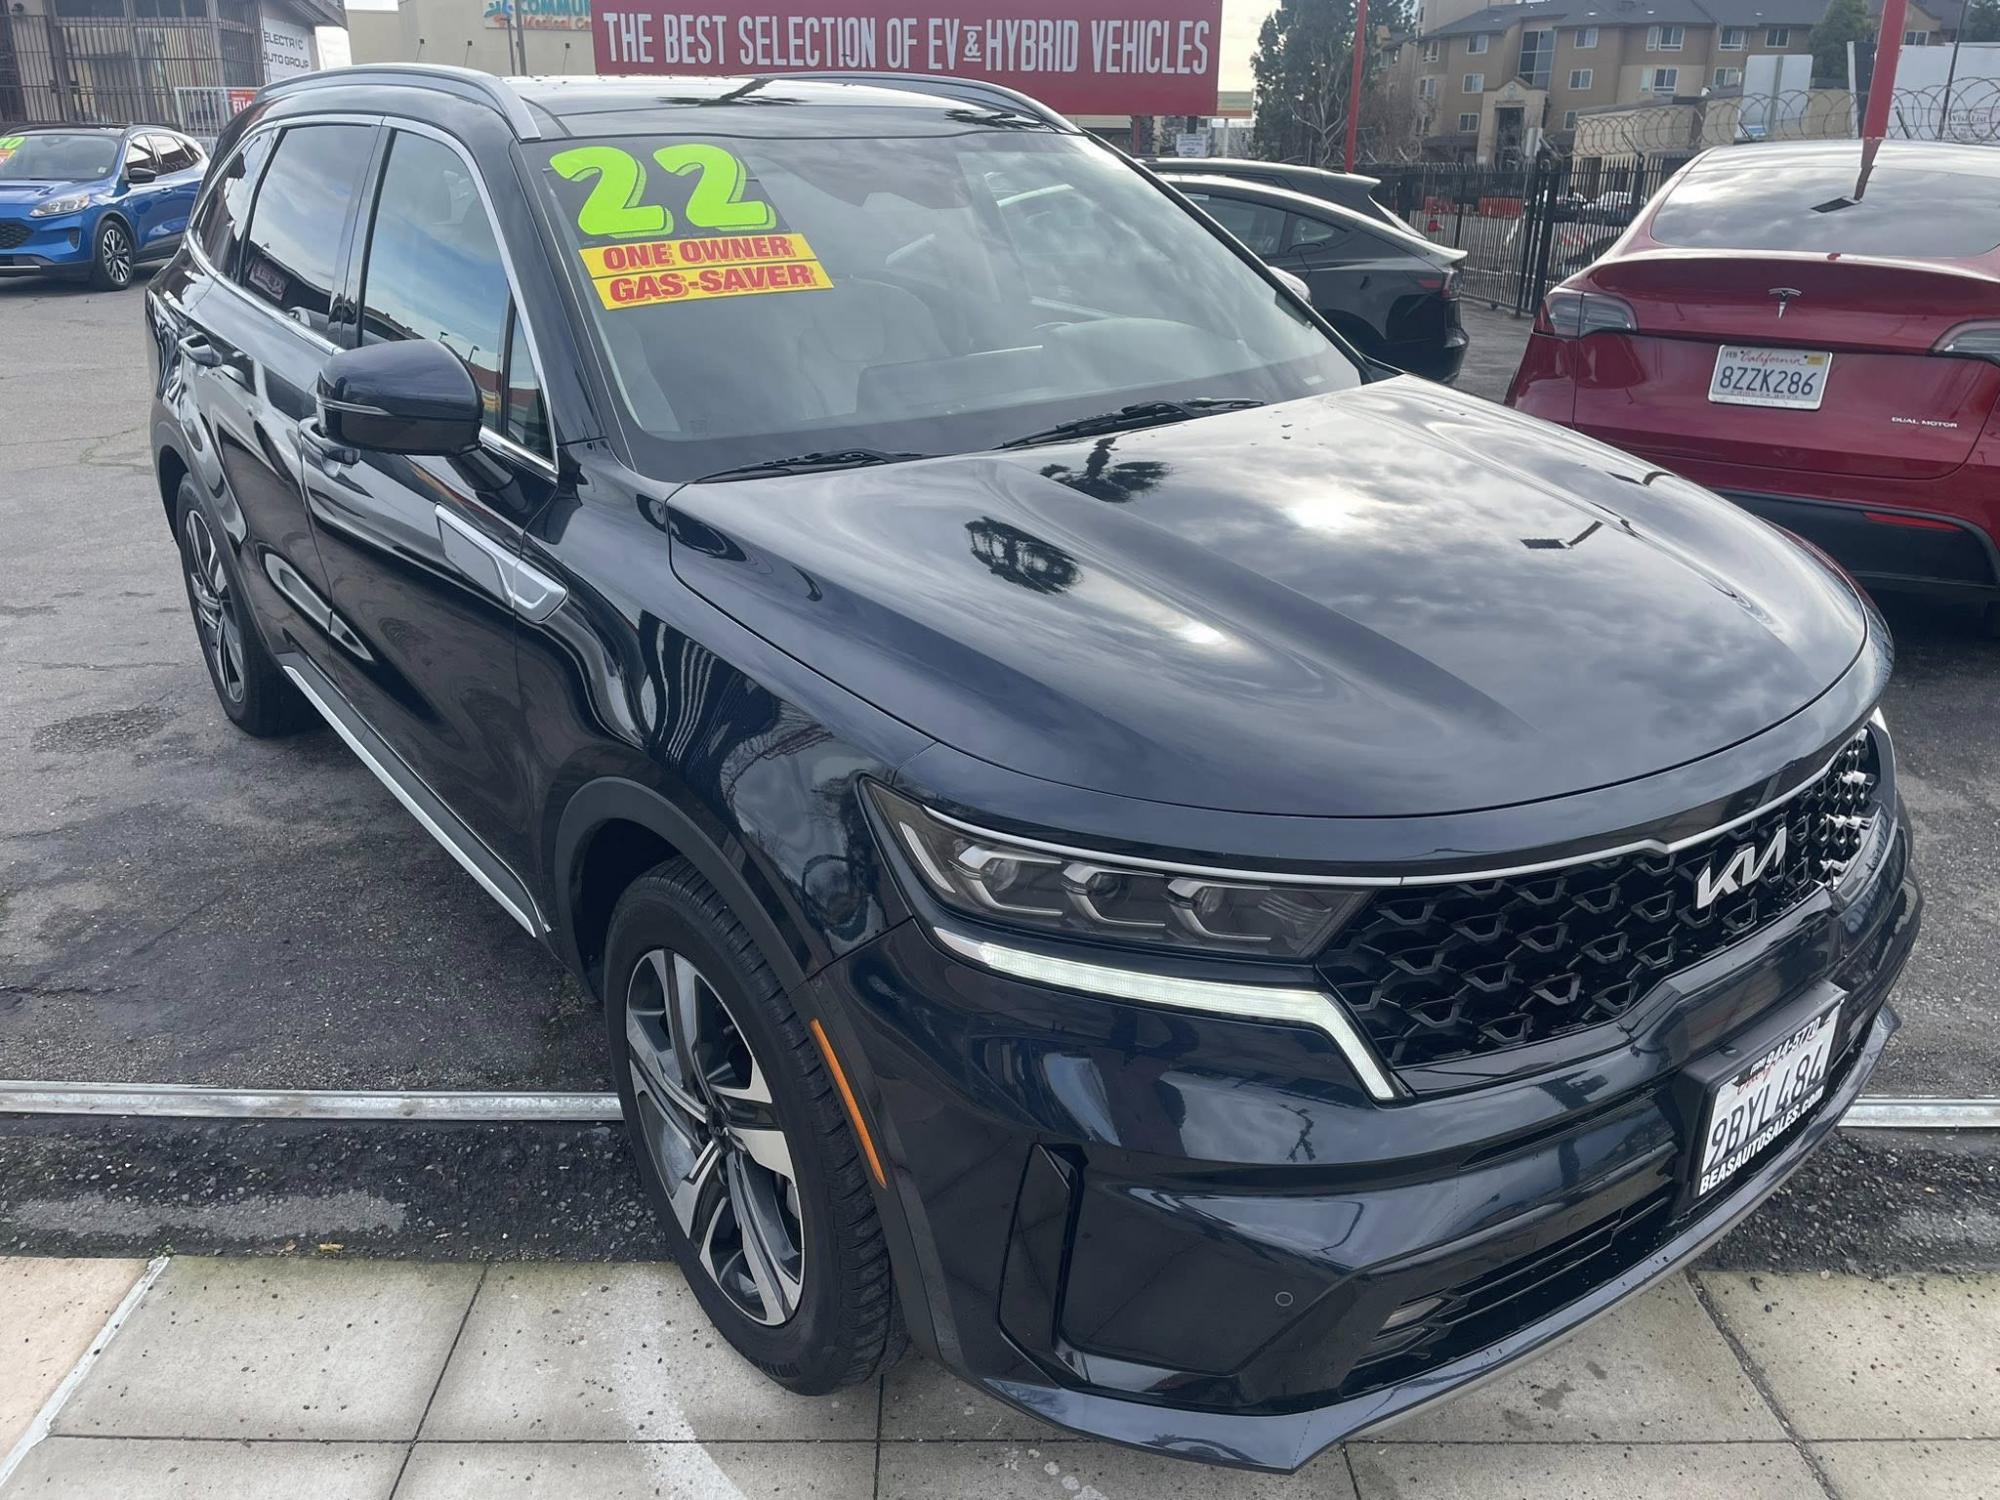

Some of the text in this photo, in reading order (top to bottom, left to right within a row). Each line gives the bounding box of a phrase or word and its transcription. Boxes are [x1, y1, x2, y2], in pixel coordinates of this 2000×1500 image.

[263, 31, 304, 50] ELECTRIC
[603, 13, 1210, 74] THE BEST SELECTION OF EV & HYBRID VEHICLES
[263, 51, 310, 68] AUTO GROUP
[549, 143, 776, 239] 22
[603, 236, 797, 271] ONE OWNER
[609, 264, 817, 304] GAS-SAVER
[1719, 366, 1817, 396] 8ZZK286
[1891, 417, 1958, 428] DUAL MOTOR
[1710, 1043, 1823, 1169] 9BYL484
[1698, 1084, 1825, 1196] BEASAUTOSALES.com
